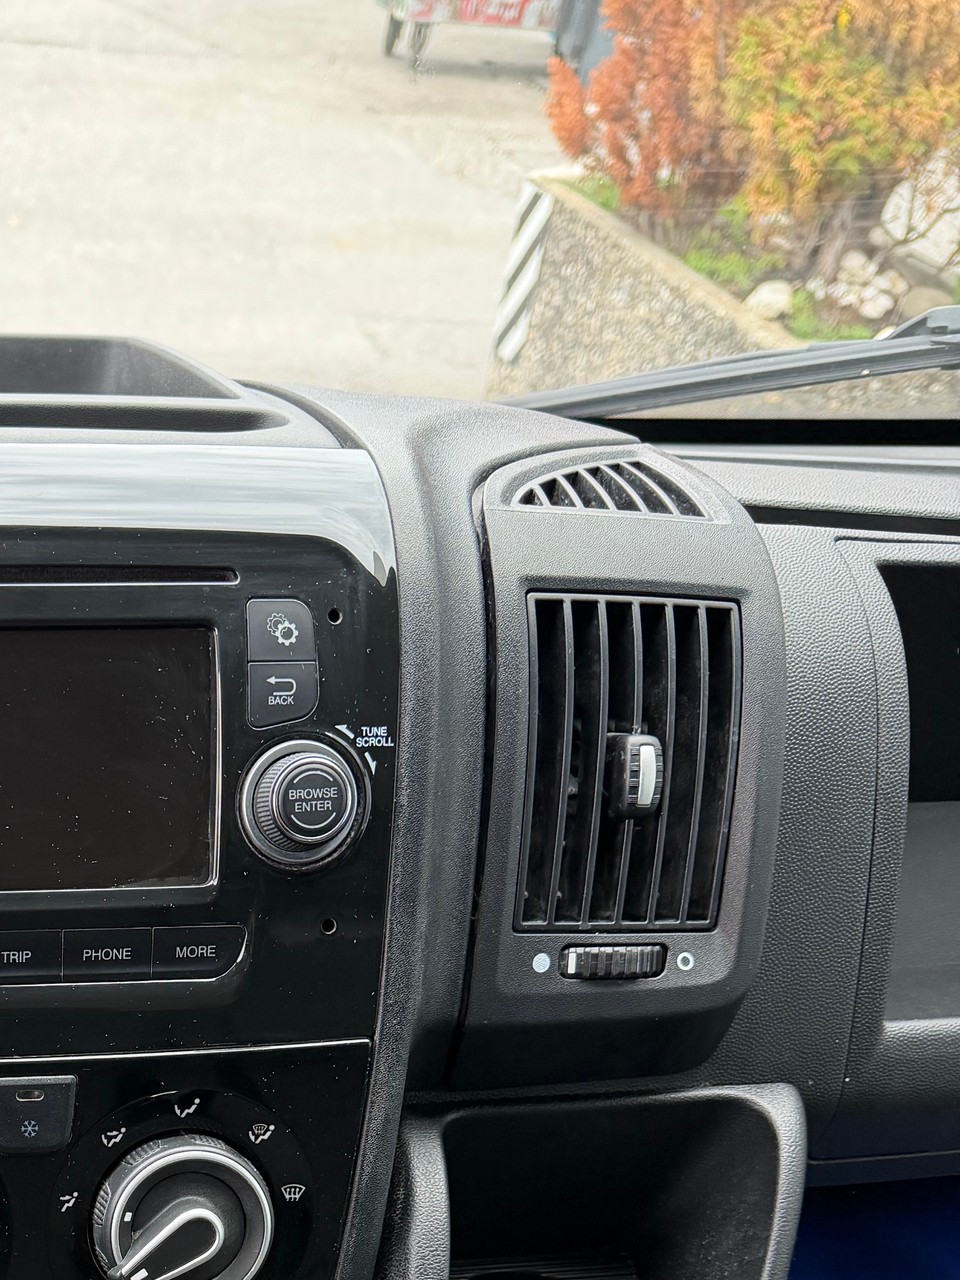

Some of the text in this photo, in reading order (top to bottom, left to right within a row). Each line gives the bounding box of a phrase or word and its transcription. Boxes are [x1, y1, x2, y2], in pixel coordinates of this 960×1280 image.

[268, 694, 295, 706] BACK
[360, 726, 388, 737] TUNE
[355, 736, 395, 748] SCROLL
[288, 786, 338, 800] BROWSE
[294, 800, 332, 813] ENTER
[0, 950, 32, 964] TRIP
[82, 947, 132, 961] PHONE
[175, 945, 217, 958] MORE
